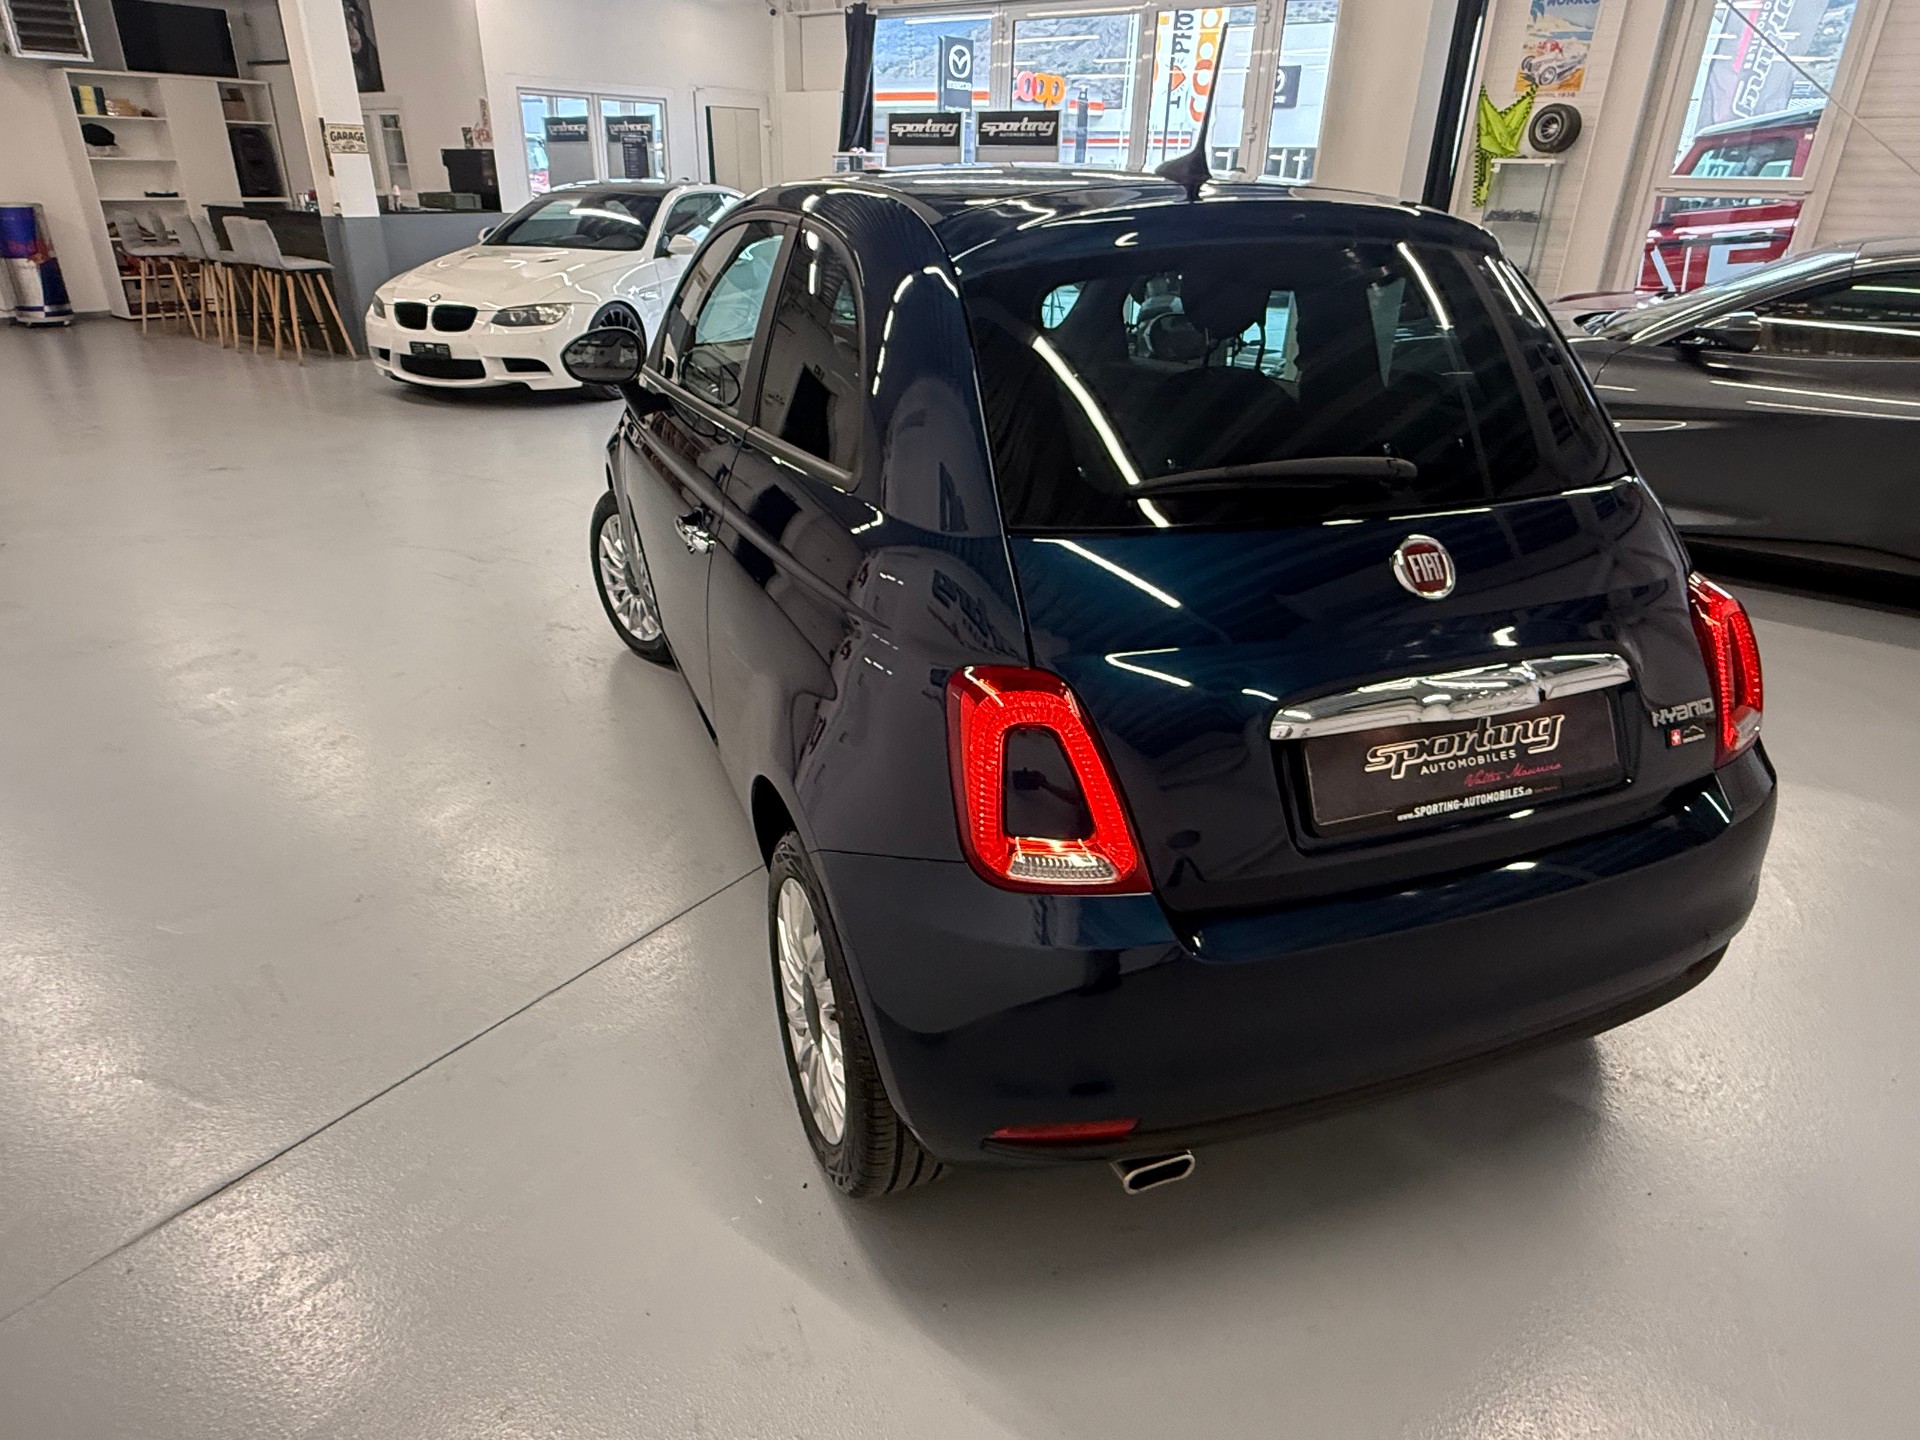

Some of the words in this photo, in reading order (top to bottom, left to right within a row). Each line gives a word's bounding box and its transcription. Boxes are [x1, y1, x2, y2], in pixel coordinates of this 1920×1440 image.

[1012, 66, 1065, 109] oop
[330, 131, 366, 143] GARAGE
[890, 118, 959, 137] sporting
[980, 116, 1057, 137] sporting
[1407, 552, 1444, 583] FIAT
[1651, 698, 1714, 728] HYBRID
[1364, 714, 1565, 780] sporting
[1420, 750, 1517, 775] AUTOMOBILES
[1397, 786, 1533, 821] www.SPORTING-AUTOMOBILES.ch
